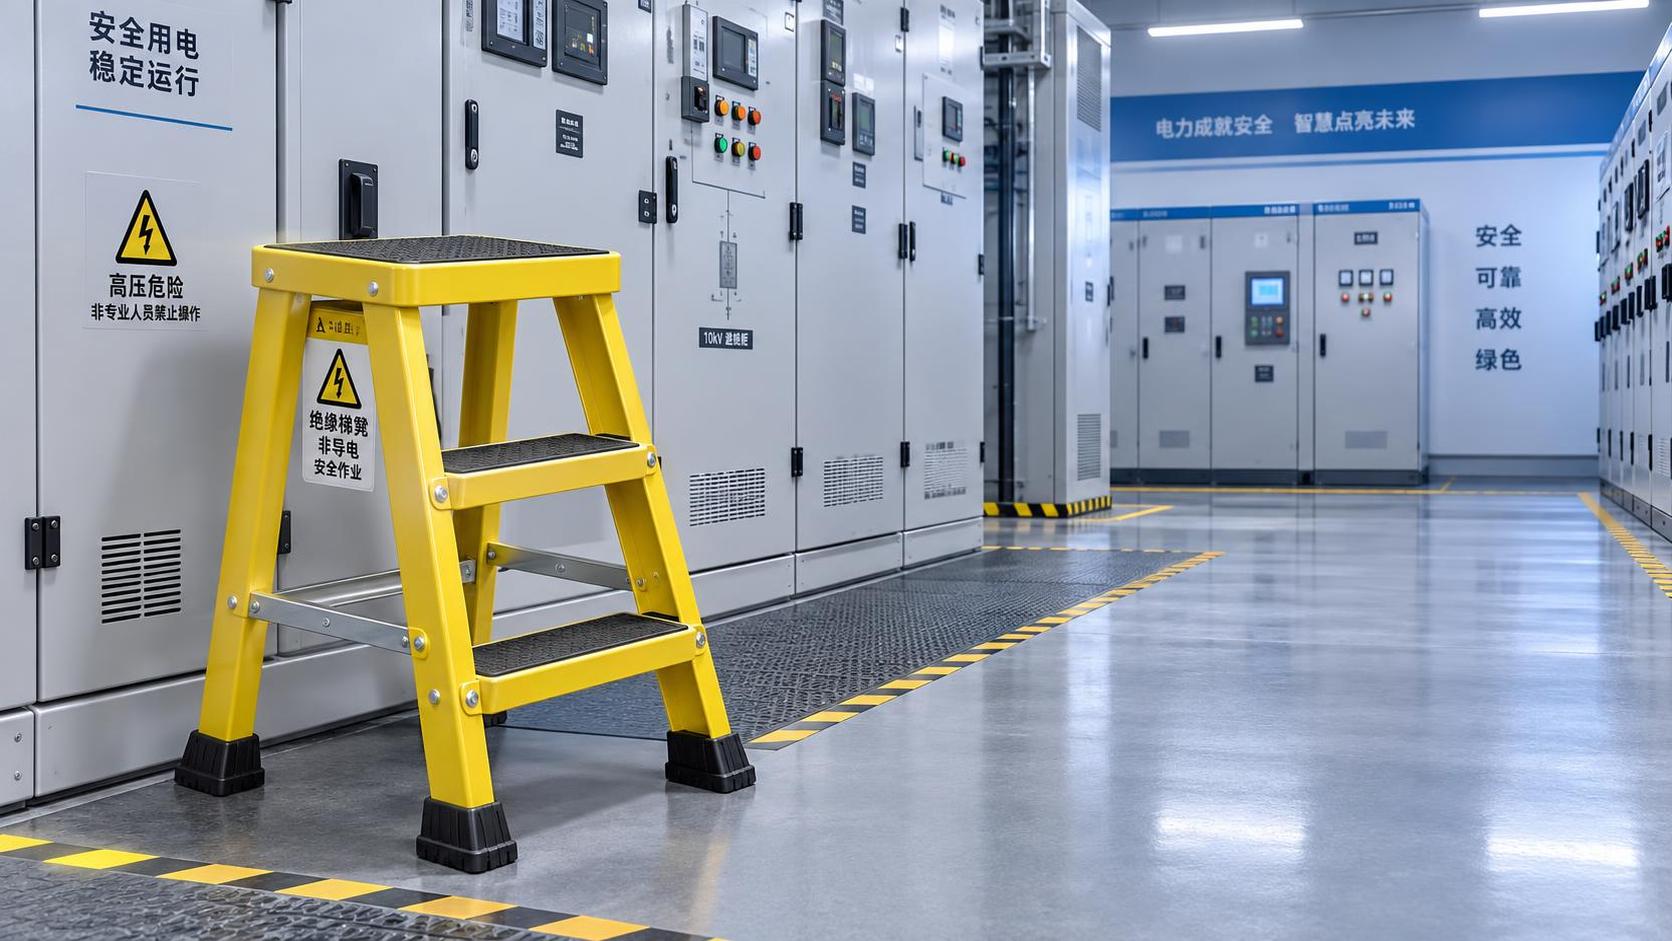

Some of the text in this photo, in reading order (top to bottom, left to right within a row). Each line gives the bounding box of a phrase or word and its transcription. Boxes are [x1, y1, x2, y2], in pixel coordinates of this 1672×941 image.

[89, 10, 199, 60] 安全用电
[89, 50, 199, 97] 稳定运行
[1156, 108, 1415, 139] 电力成就安全 智慧点亮未来
[1475, 224, 1522, 248] 安全
[109, 272, 184, 299] 高压危险
[1475, 265, 1522, 289] 可靠
[91, 302, 201, 322] 非专业人员禁止操作
[1475, 307, 1522, 330] 高效
[703, 331, 723, 345] 10kV
[1475, 348, 1522, 371] 绿色
[318, 435, 359, 459] 非导电
[314, 458, 362, 480] 安全作业
